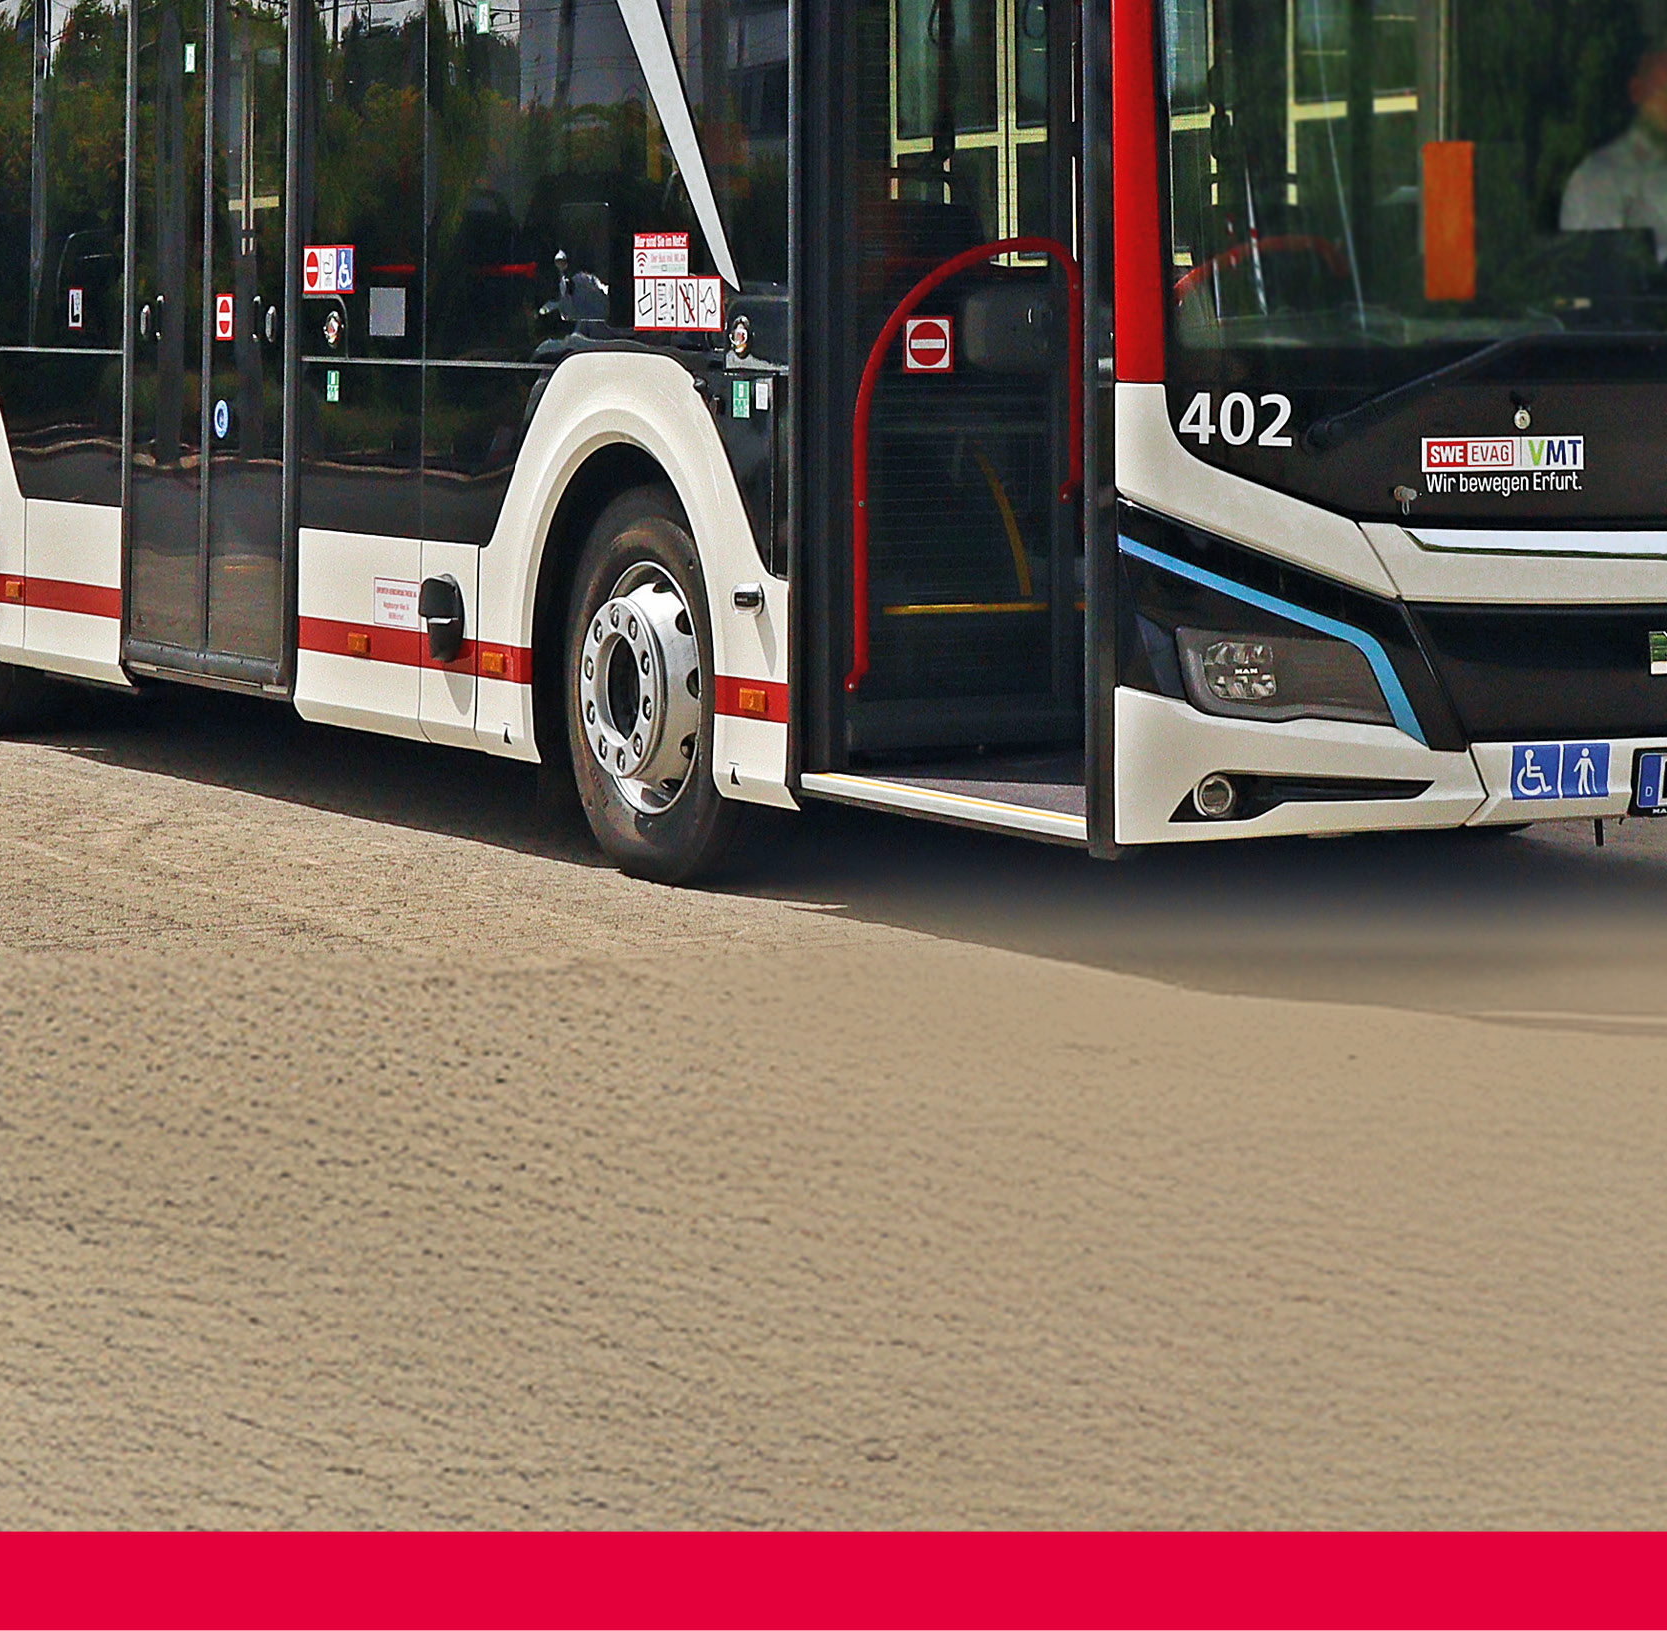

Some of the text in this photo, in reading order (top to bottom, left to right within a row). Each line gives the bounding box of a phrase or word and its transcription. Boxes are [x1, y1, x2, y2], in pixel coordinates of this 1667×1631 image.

[1179, 392, 1293, 447] 402
[1430, 444, 1509, 464] SWE EVAG
[1528, 440, 1582, 466] VMT
[1426, 472, 1582, 497] Wir bewegen Erfurt.
[1644, 785, 1653, 797] D
